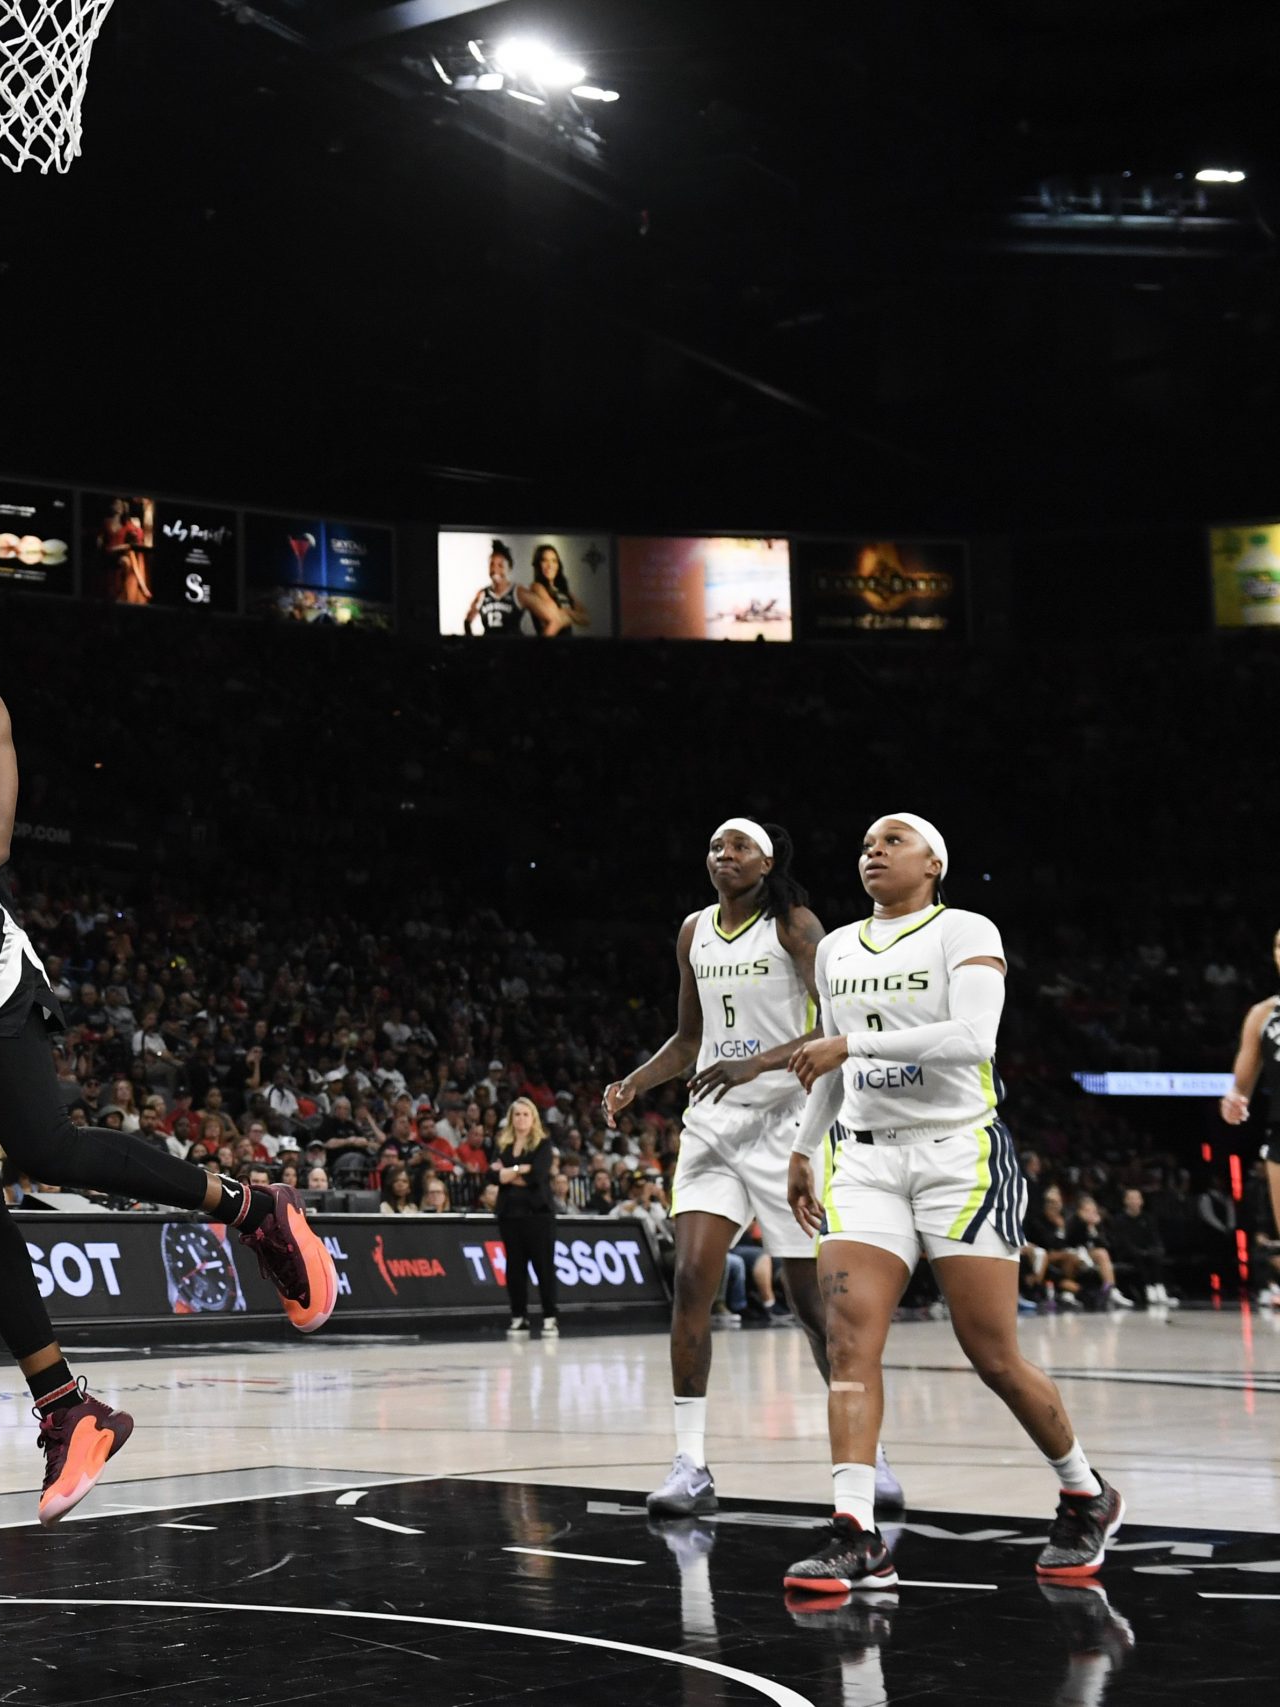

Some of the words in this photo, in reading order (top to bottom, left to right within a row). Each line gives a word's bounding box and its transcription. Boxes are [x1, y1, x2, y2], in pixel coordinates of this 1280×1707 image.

[696, 959, 769, 979] WINGS
[830, 970, 929, 998] WINGS
[722, 994, 735, 1028] 6
[720, 1040, 760, 1058] GEM
[866, 1065, 923, 1090] GEM
[387, 1258, 446, 1277] WNBA
[463, 1246, 486, 1281] T
